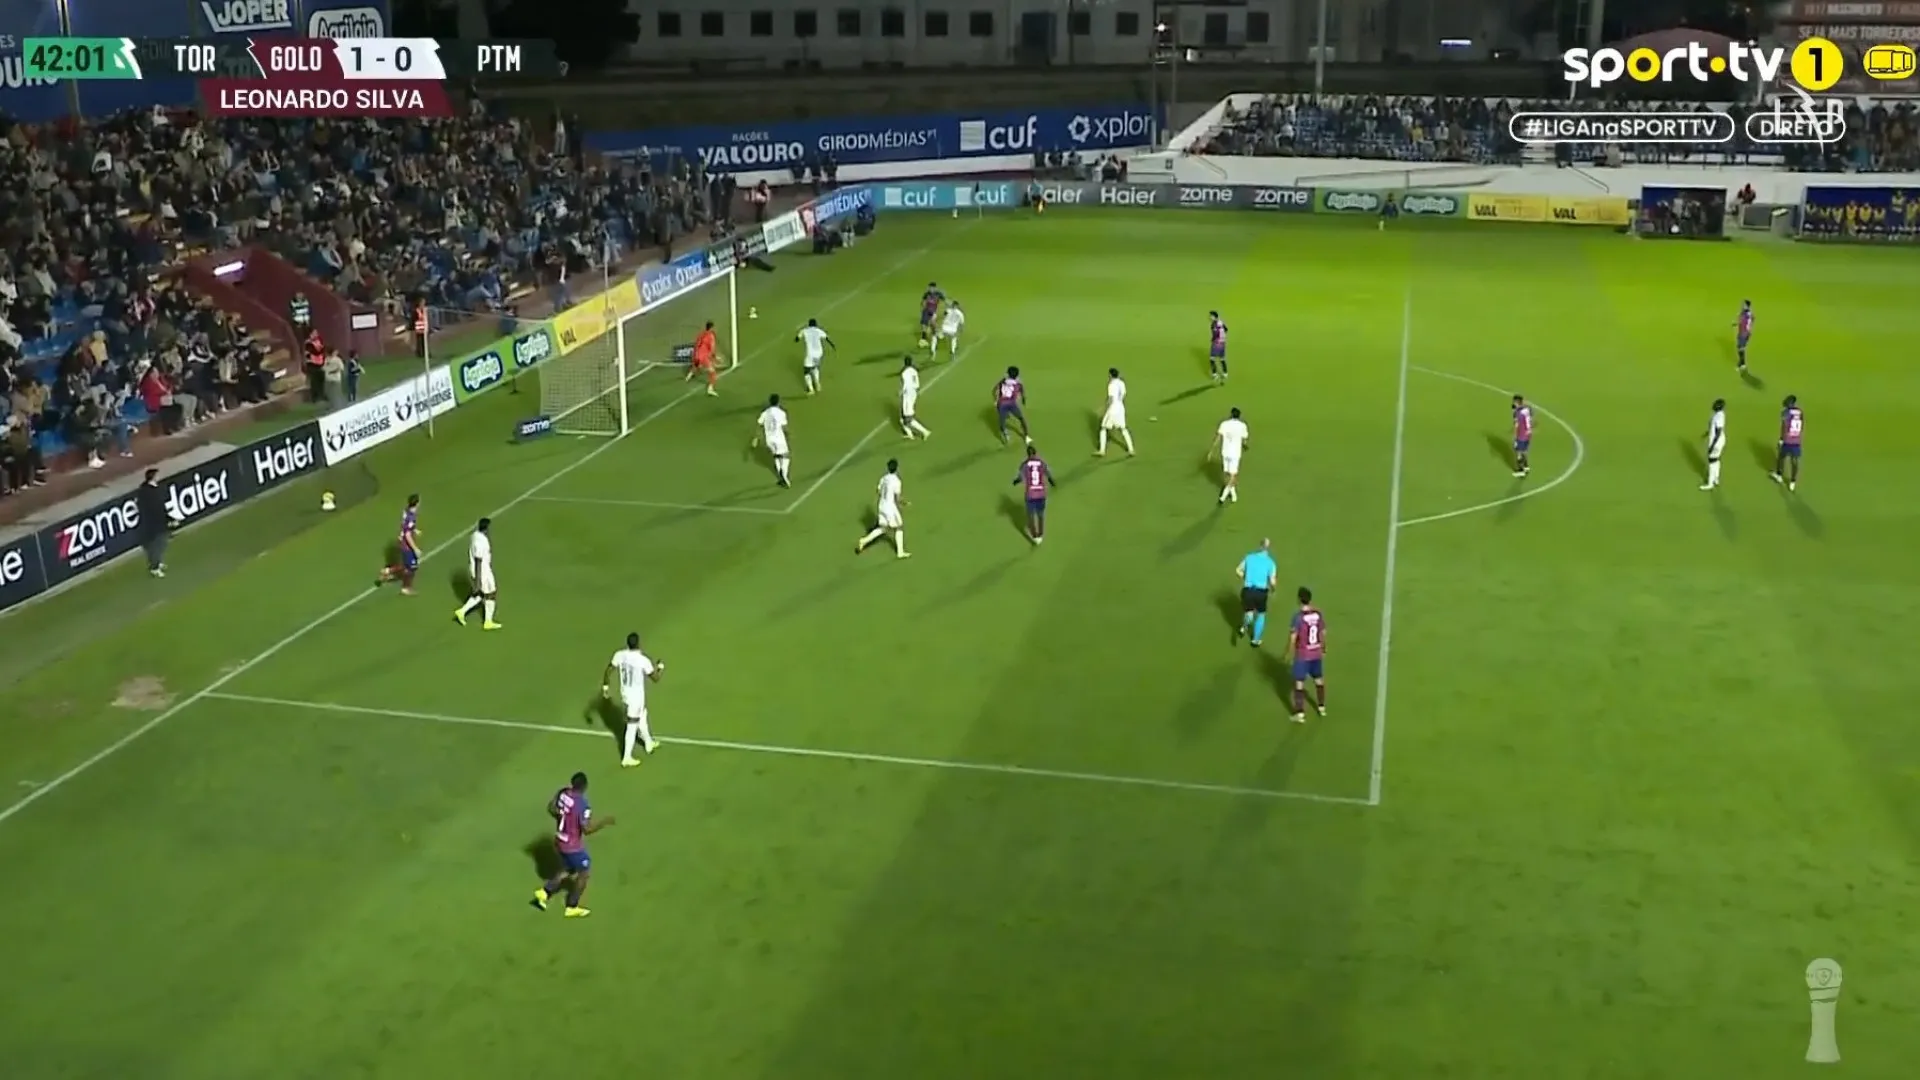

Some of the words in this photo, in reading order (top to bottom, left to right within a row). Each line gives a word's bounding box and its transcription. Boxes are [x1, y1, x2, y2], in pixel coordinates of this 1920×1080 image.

[217, 0, 289, 26] JOPER
[989, 115, 1037, 149] cuf
[697, 141, 804, 166] VALOURO
[904, 186, 937, 207] cuf
[974, 185, 1008, 205] cuf
[1100, 186, 1156, 205] Haier
[1180, 187, 1233, 202] zome
[1254, 189, 1308, 204] zome
[253, 436, 314, 485] Haier
[64, 500, 140, 556] zome
